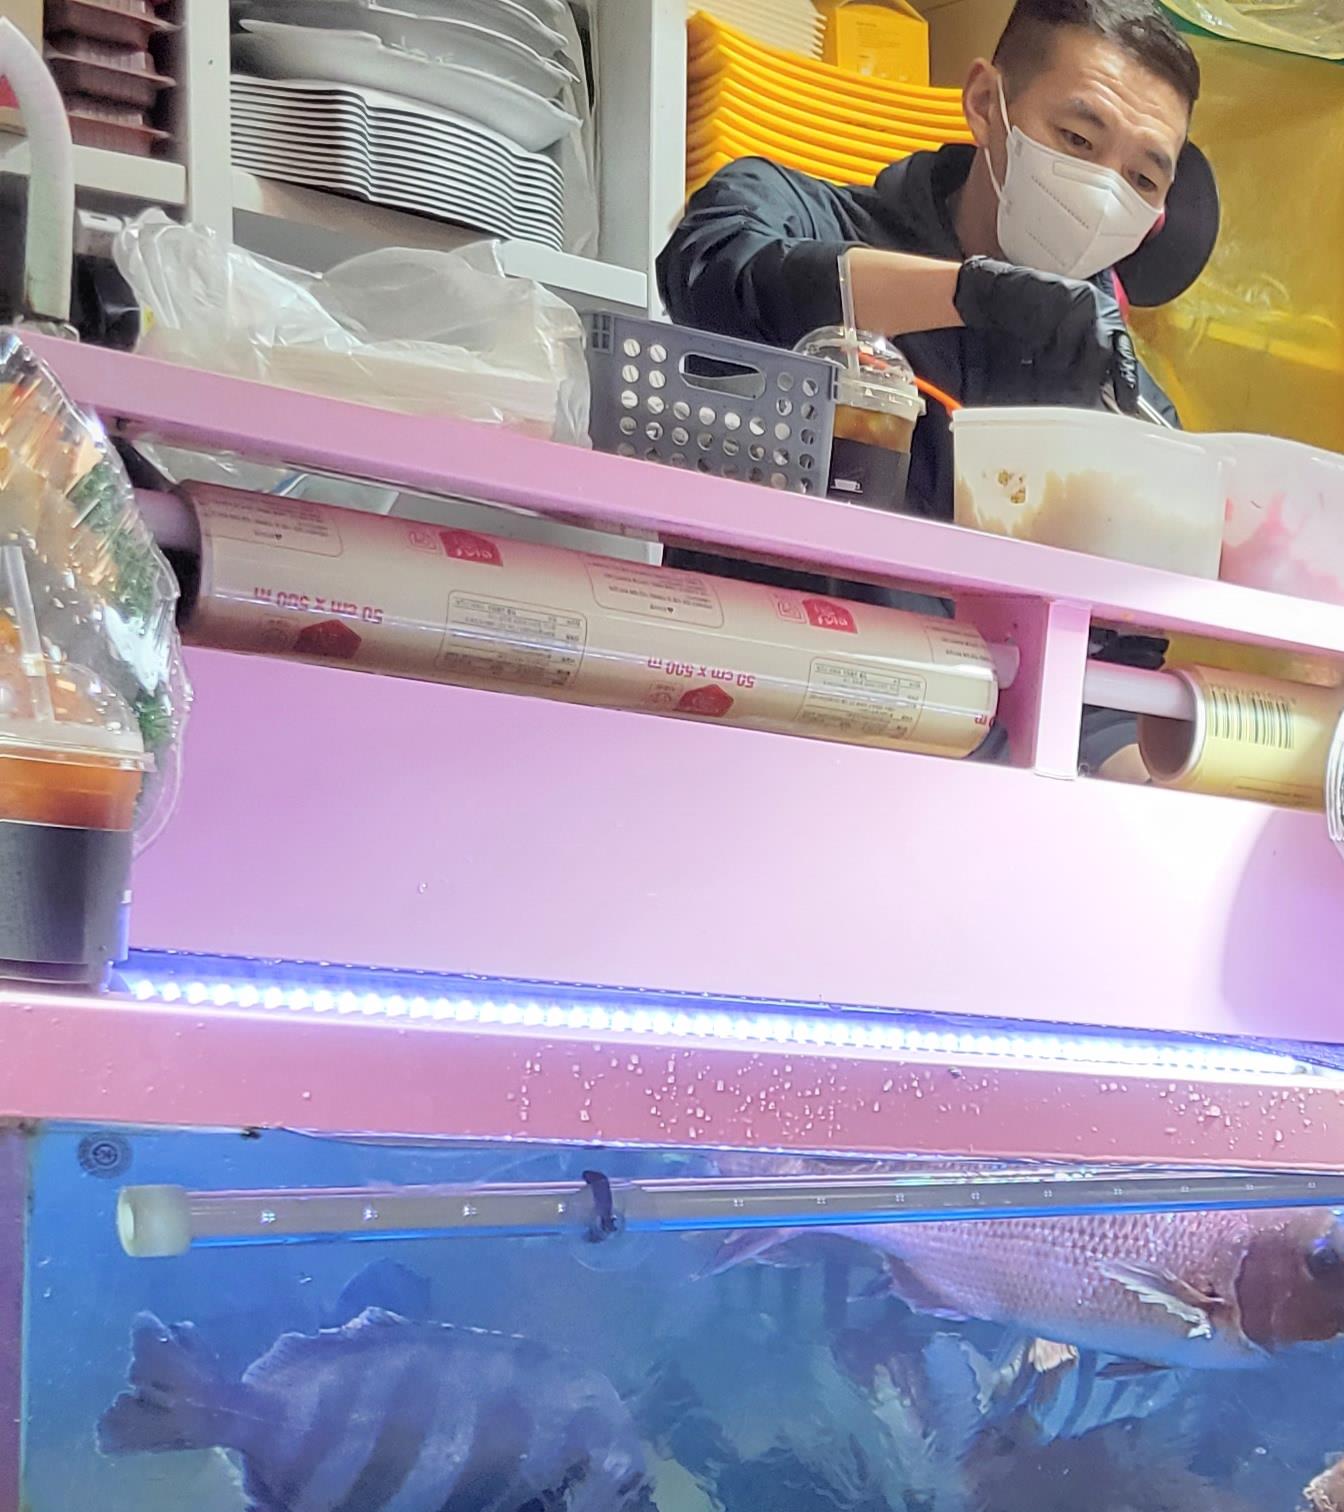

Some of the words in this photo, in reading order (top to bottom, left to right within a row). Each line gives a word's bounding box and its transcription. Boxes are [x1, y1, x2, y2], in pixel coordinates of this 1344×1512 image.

[665, 661, 694, 679] 500
[711, 667, 734, 683] cm
[736, 670, 757, 689] 50
